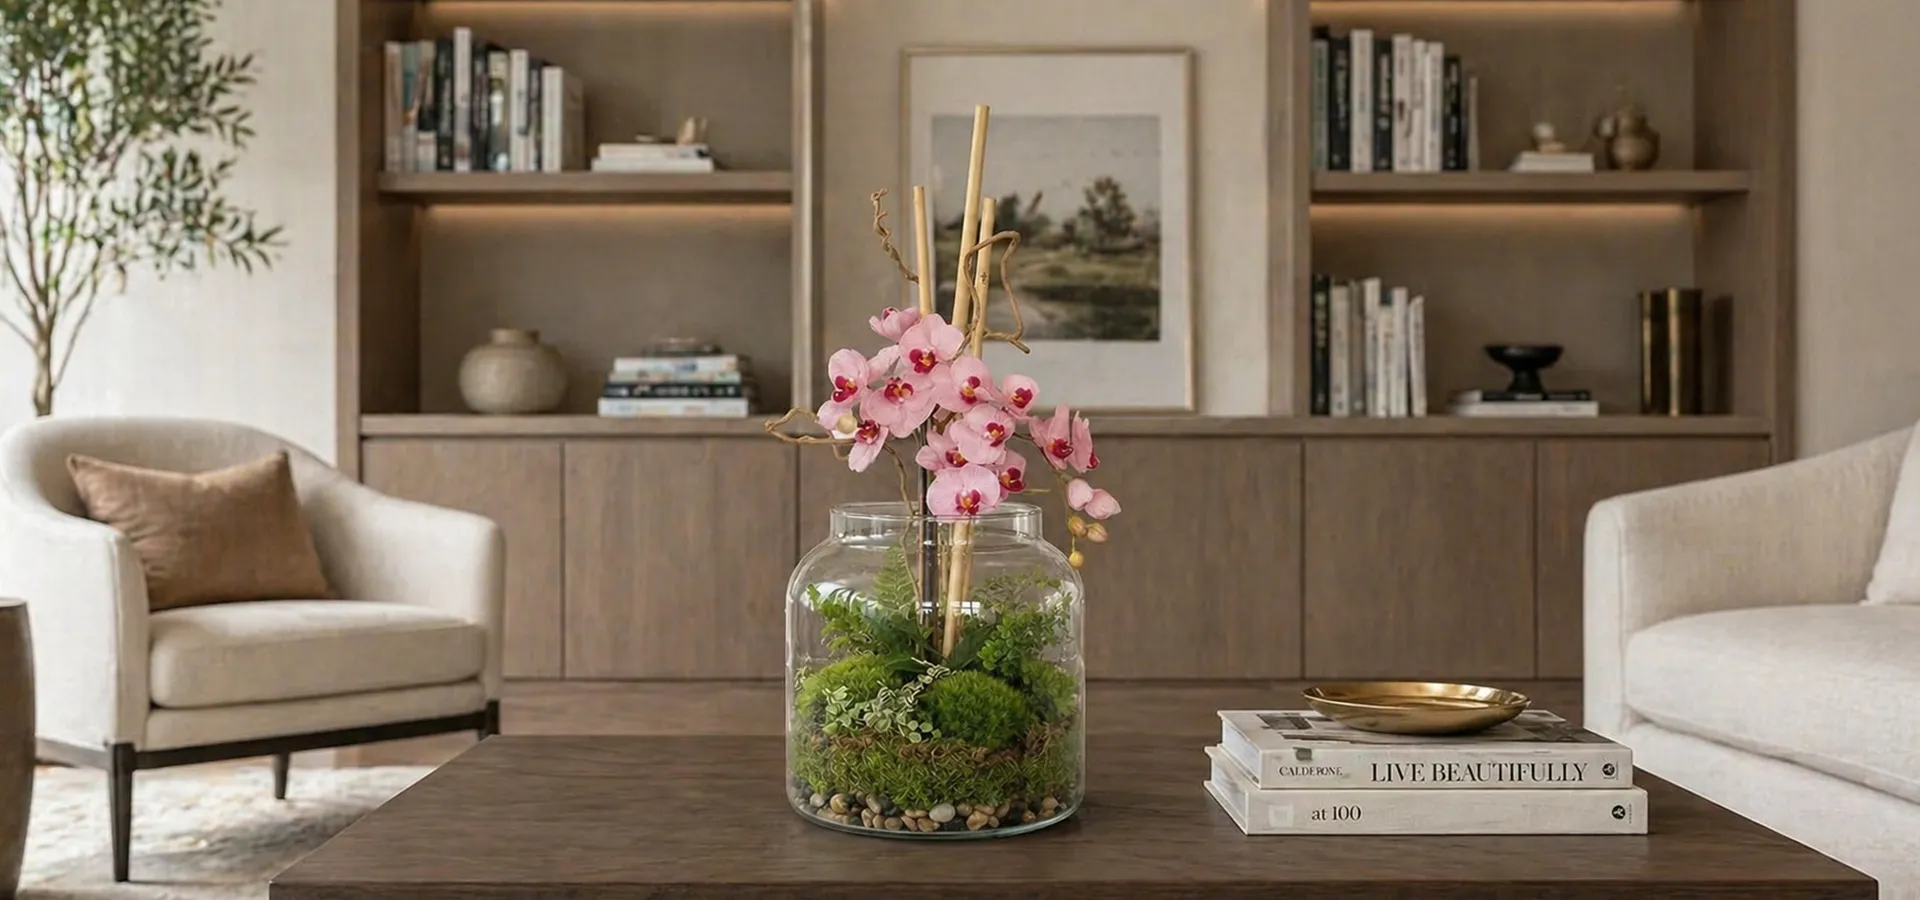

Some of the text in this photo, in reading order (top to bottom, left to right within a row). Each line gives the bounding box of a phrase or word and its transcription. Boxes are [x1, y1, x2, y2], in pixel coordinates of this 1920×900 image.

[1371, 763, 1588, 782] LIVE BEAUTIFULLY
[1311, 805, 1362, 821] at 100
